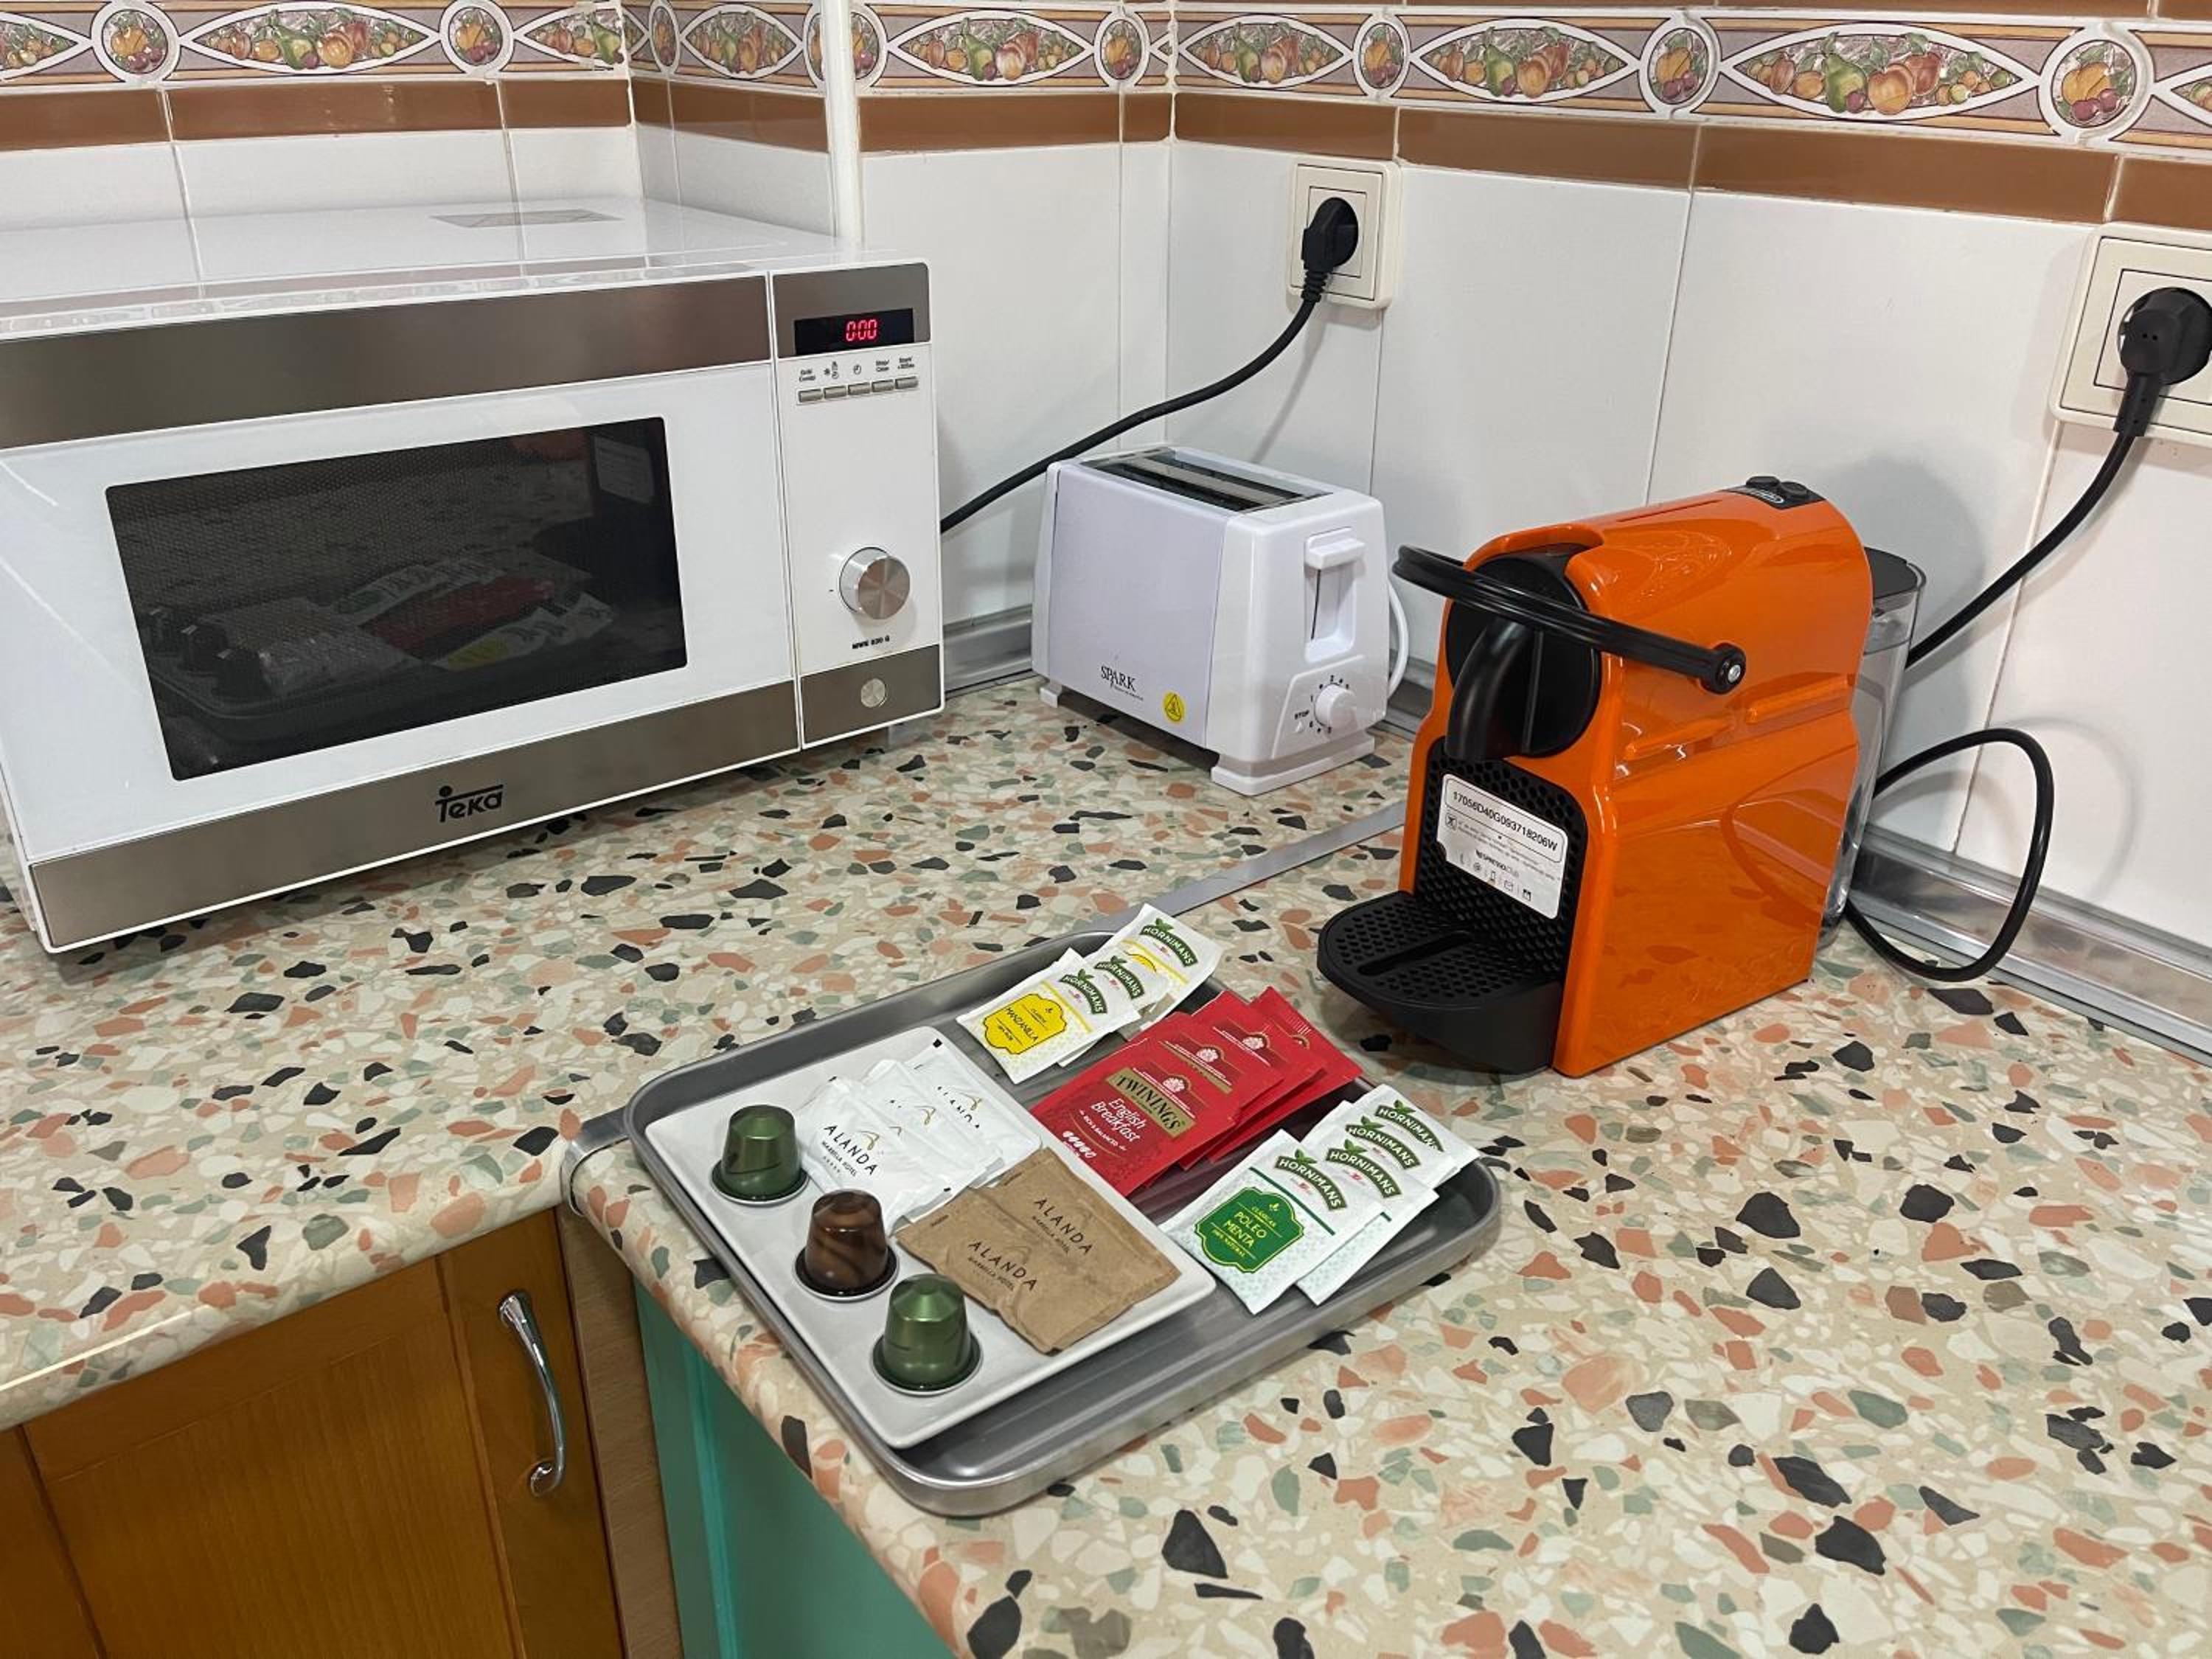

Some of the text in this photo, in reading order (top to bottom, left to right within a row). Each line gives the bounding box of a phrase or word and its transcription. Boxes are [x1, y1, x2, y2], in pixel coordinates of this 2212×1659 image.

[1101, 665, 1136, 692] SPARK
[1144, 927, 1194, 964] HORNIMANS
[1065, 975, 1104, 1013] HORNIMANS
[1096, 962, 1141, 997] HORNIMANS
[1108, 1098, 1147, 1130] English
[1116, 1074, 1180, 1129] TWININGS
[1091, 1101, 1141, 1142] Breakfast
[824, 1125, 877, 1175] ALANDA
[1349, 1127, 1415, 1166] HORNIMANS
[1279, 1158, 1341, 1207] HORNIMANS
[1329, 1151, 1396, 1194] HORNIMANS
[1034, 1199, 1093, 1255] ALANDA
[1222, 1220, 1254, 1248] MENTA
[1234, 1211, 1267, 1238] POLEO
[967, 1242, 1037, 1291] ALANDA
